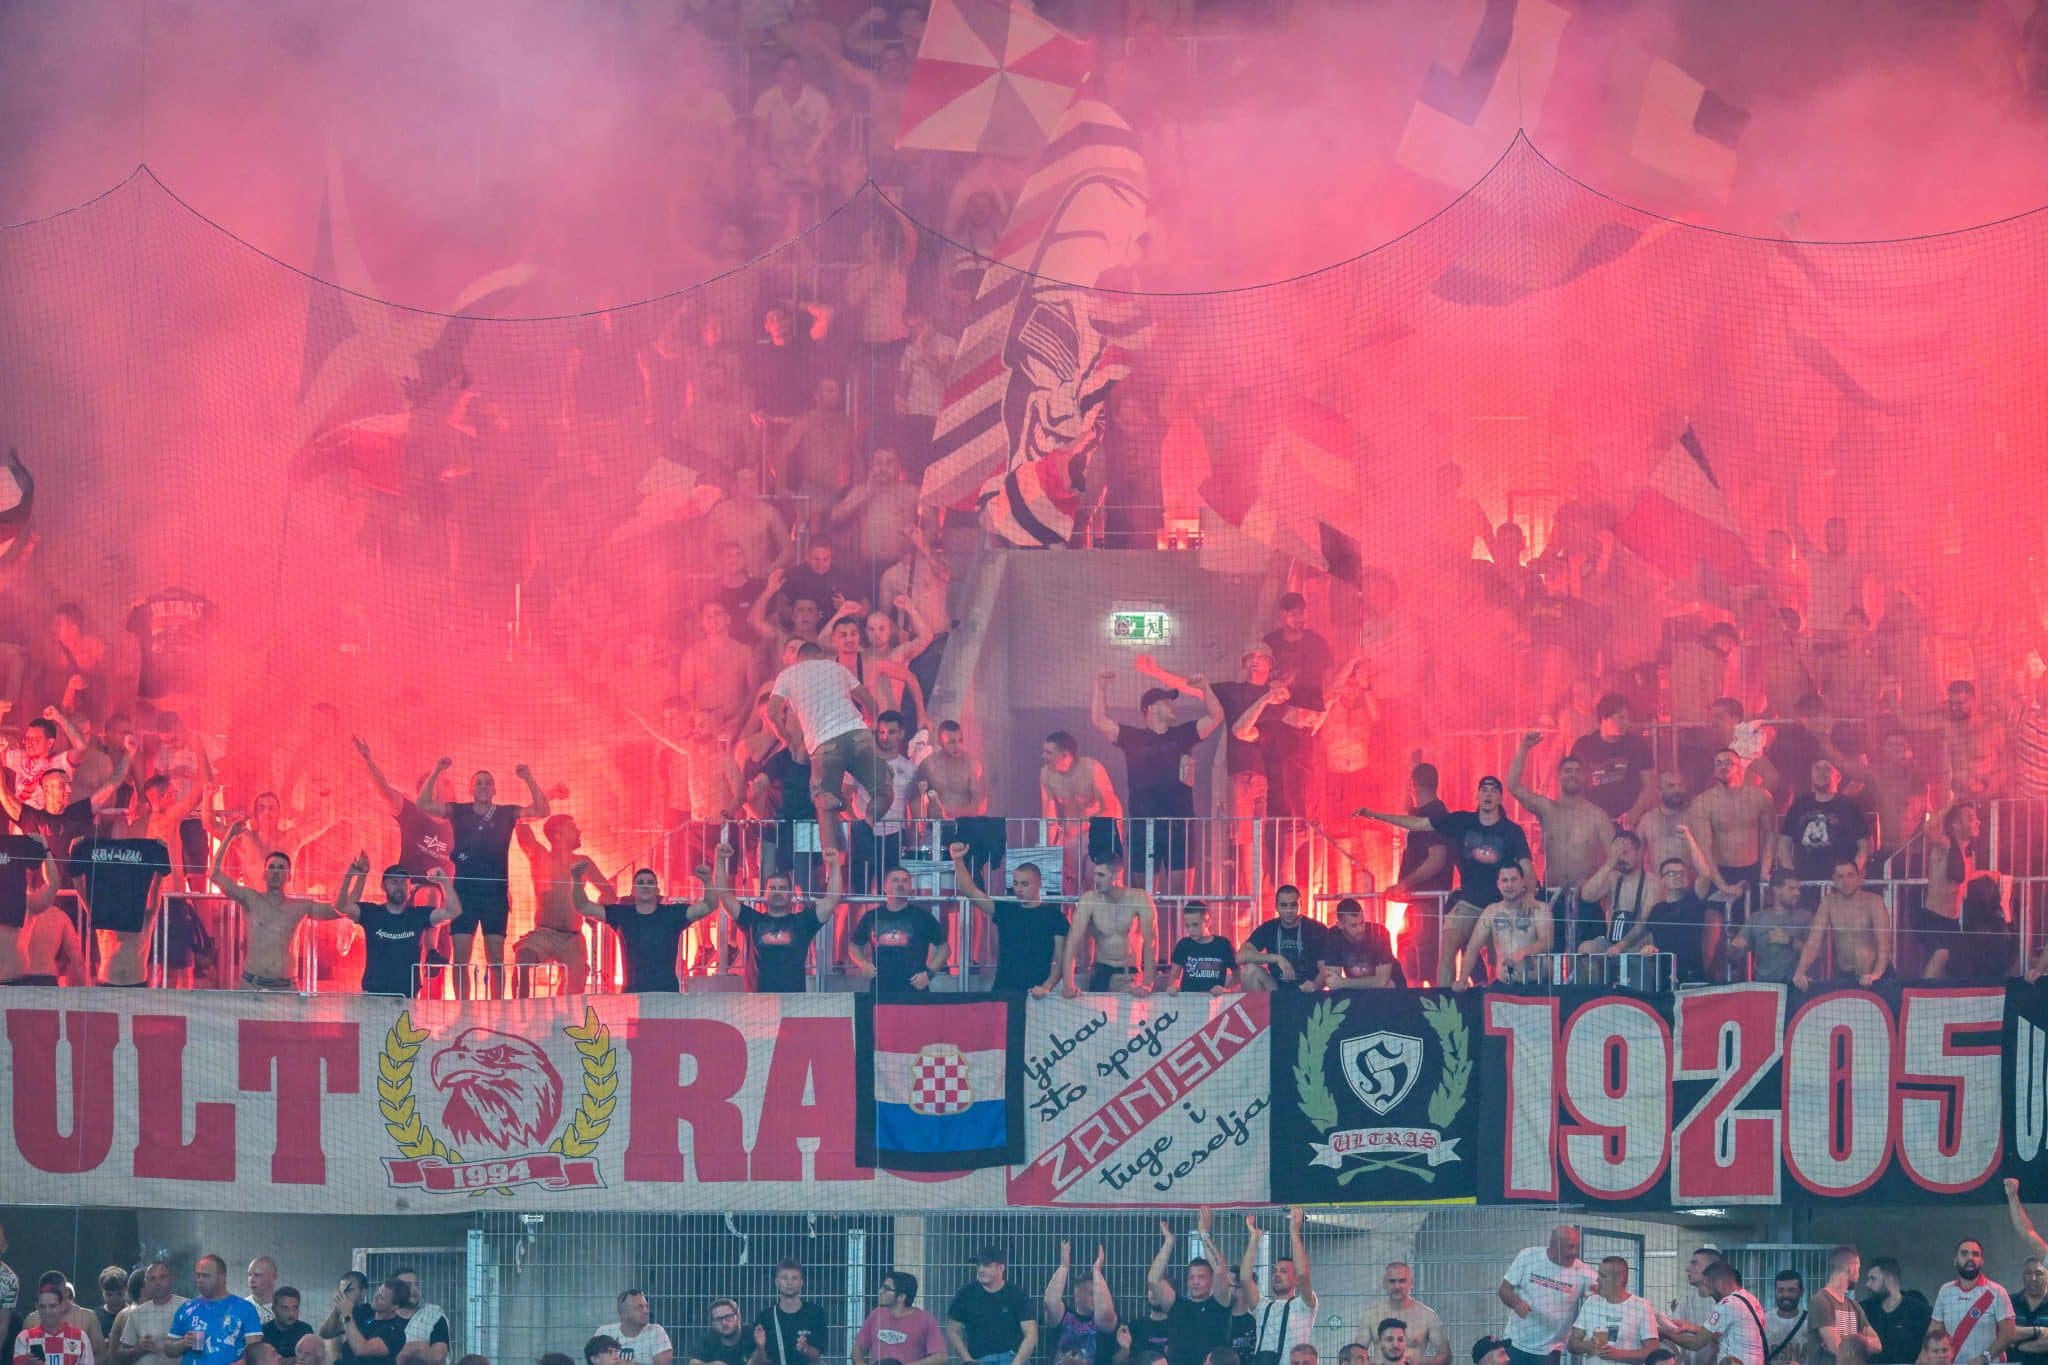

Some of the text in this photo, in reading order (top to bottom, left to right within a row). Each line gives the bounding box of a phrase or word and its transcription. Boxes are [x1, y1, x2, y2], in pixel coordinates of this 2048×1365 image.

[1024, 1011, 1108, 1090] ljubav
[1096, 1010, 1179, 1080] spaja
[1039, 1003, 1258, 1191] ZRINJSKI
[2015, 1015, 2048, 1162] U
[452, 1160, 532, 1188] 1994
[1099, 1101, 1206, 1191] tuge i
[1153, 1094, 1271, 1191] veselja
[1332, 1131, 1438, 1153] ULTRAS
